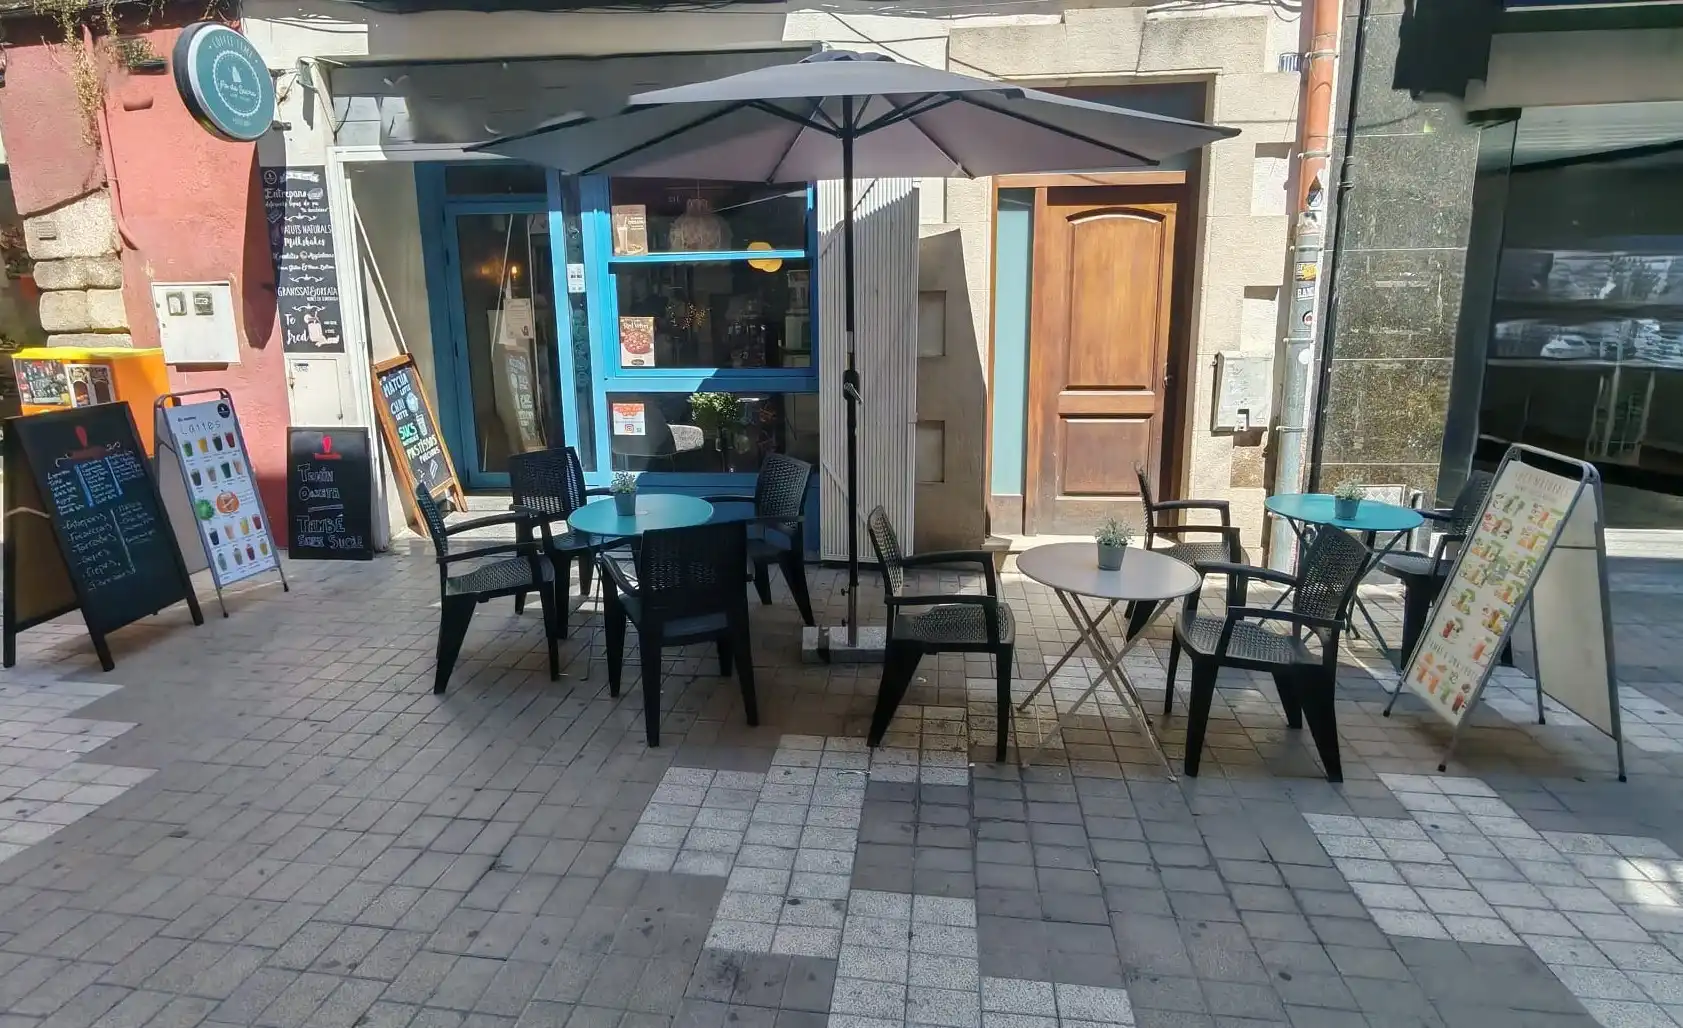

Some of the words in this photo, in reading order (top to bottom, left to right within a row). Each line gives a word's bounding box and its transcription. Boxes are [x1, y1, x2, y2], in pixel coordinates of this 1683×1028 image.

[302, 224, 332, 234] NATURALS
[382, 372, 408, 398] MATCHA
[390, 398, 405, 415] CHAI
[398, 422, 417, 440] SUCS
